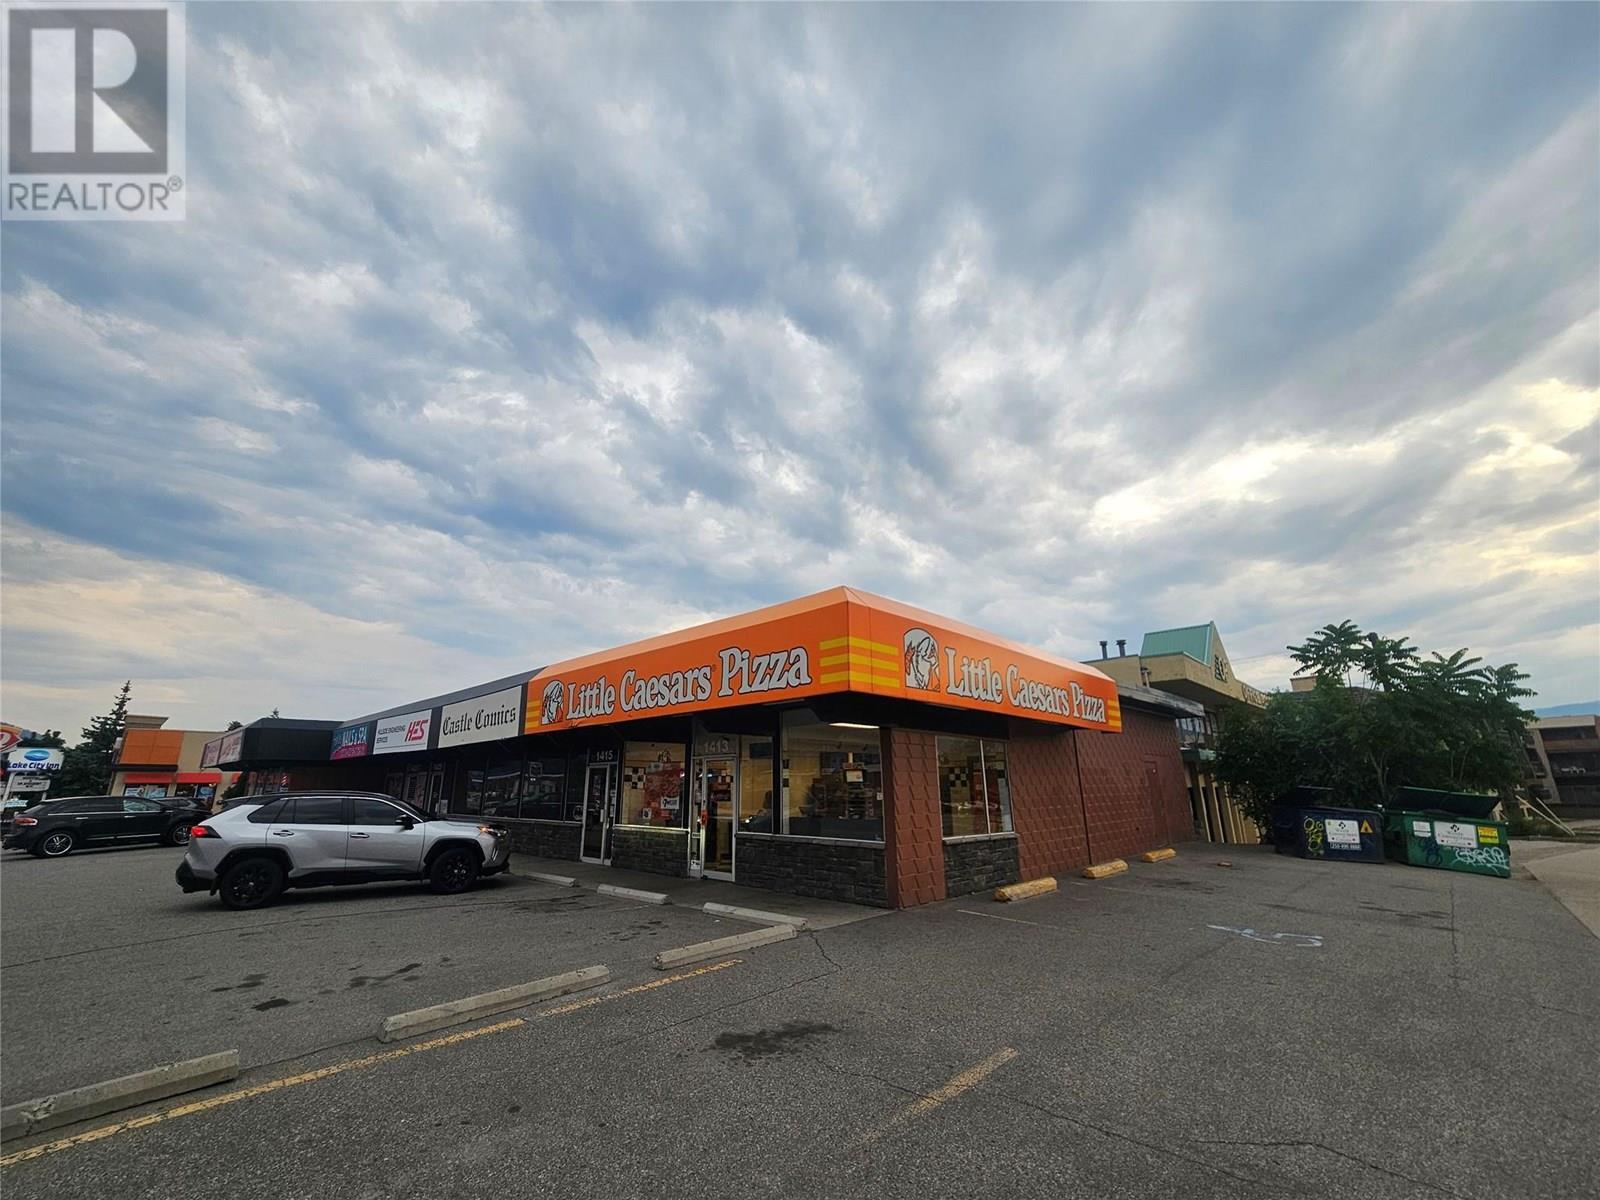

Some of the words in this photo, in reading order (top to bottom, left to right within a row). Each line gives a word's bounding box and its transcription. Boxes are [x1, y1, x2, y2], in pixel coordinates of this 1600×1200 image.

[566, 676, 616, 720] Little
[619, 664, 712, 712] Caesars
[718, 647, 812, 698] Pizza
[944, 646, 1003, 704] Little
[1005, 663, 1070, 718] Caesars
[1069, 681, 1106, 723] Pizza
[442, 714, 473, 736] Castle
[475, 704, 516, 730] Comics
[596, 750, 613, 761] 1415
[704, 740, 729, 753] 1413
[8, 761, 28, 769] Lake
[29, 761, 46, 770] City
[46, 762, 60, 770] Inn
